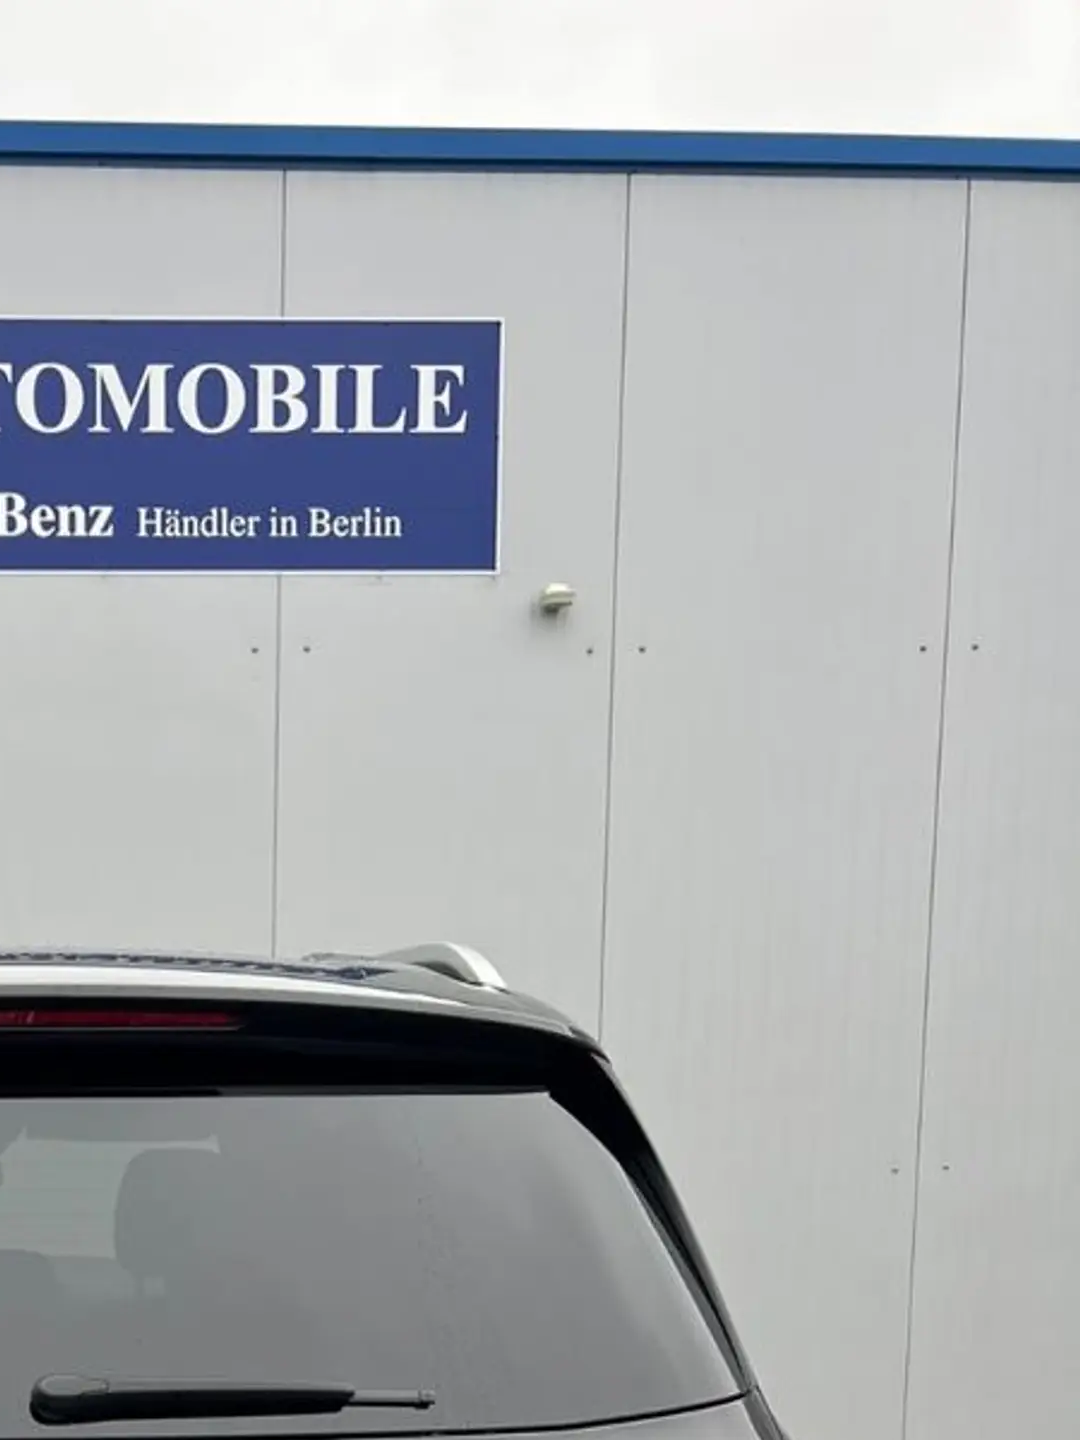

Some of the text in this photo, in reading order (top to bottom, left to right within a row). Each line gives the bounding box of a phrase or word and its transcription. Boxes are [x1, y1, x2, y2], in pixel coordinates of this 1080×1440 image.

[138, 507, 260, 537] Händler
[270, 507, 298, 537] in
[309, 508, 402, 537] Berlin
